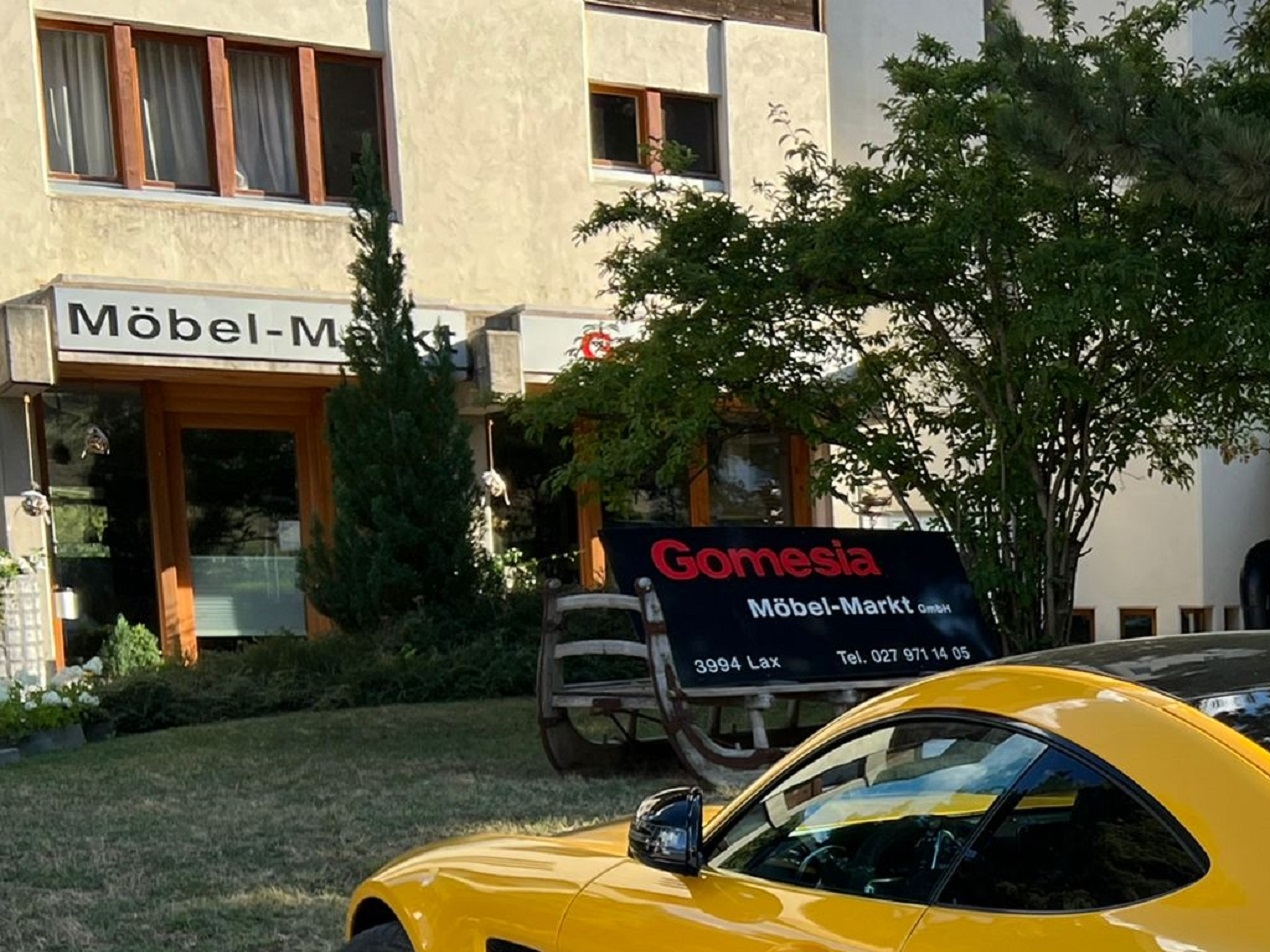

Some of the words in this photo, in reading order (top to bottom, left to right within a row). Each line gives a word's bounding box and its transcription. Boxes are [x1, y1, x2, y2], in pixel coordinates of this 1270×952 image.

[650, 538, 882, 581] Gomesia
[747, 595, 915, 619] Möbel-Markt
[917, 602, 952, 614] GmbH
[694, 656, 741, 674] 3994
[748, 655, 781, 670] Lax
[837, 649, 867, 666] Tel.
[872, 648, 897, 664] 027
[904, 647, 928, 663] 971
[932, 646, 948, 662] 14
[953, 646, 970, 661] 05
